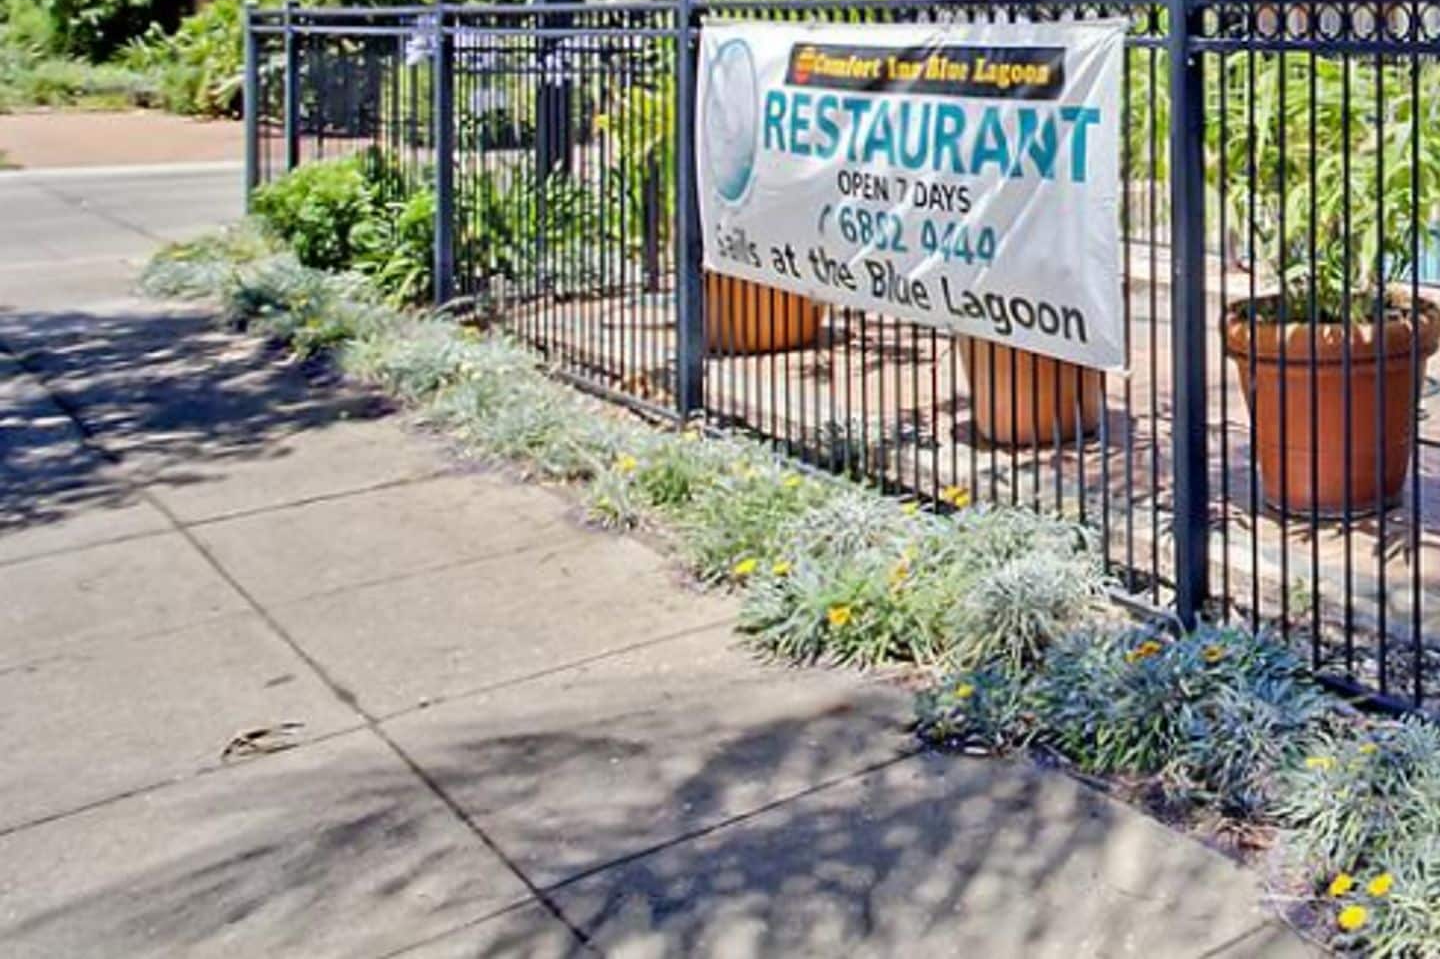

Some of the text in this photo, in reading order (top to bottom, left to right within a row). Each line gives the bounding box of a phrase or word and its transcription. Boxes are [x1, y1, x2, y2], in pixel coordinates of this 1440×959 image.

[813, 53, 881, 79] Comfort
[973, 56, 1050, 88] Lagoon
[762, 89, 1101, 183] RESTAURANT
[837, 169, 972, 213] OPEN 7 DAYS
[839, 205, 908, 253] 6852
[770, 242, 802, 280] at
[807, 245, 857, 291] the
[864, 258, 930, 311] Blue
[941, 274, 1089, 343] Lagoon
